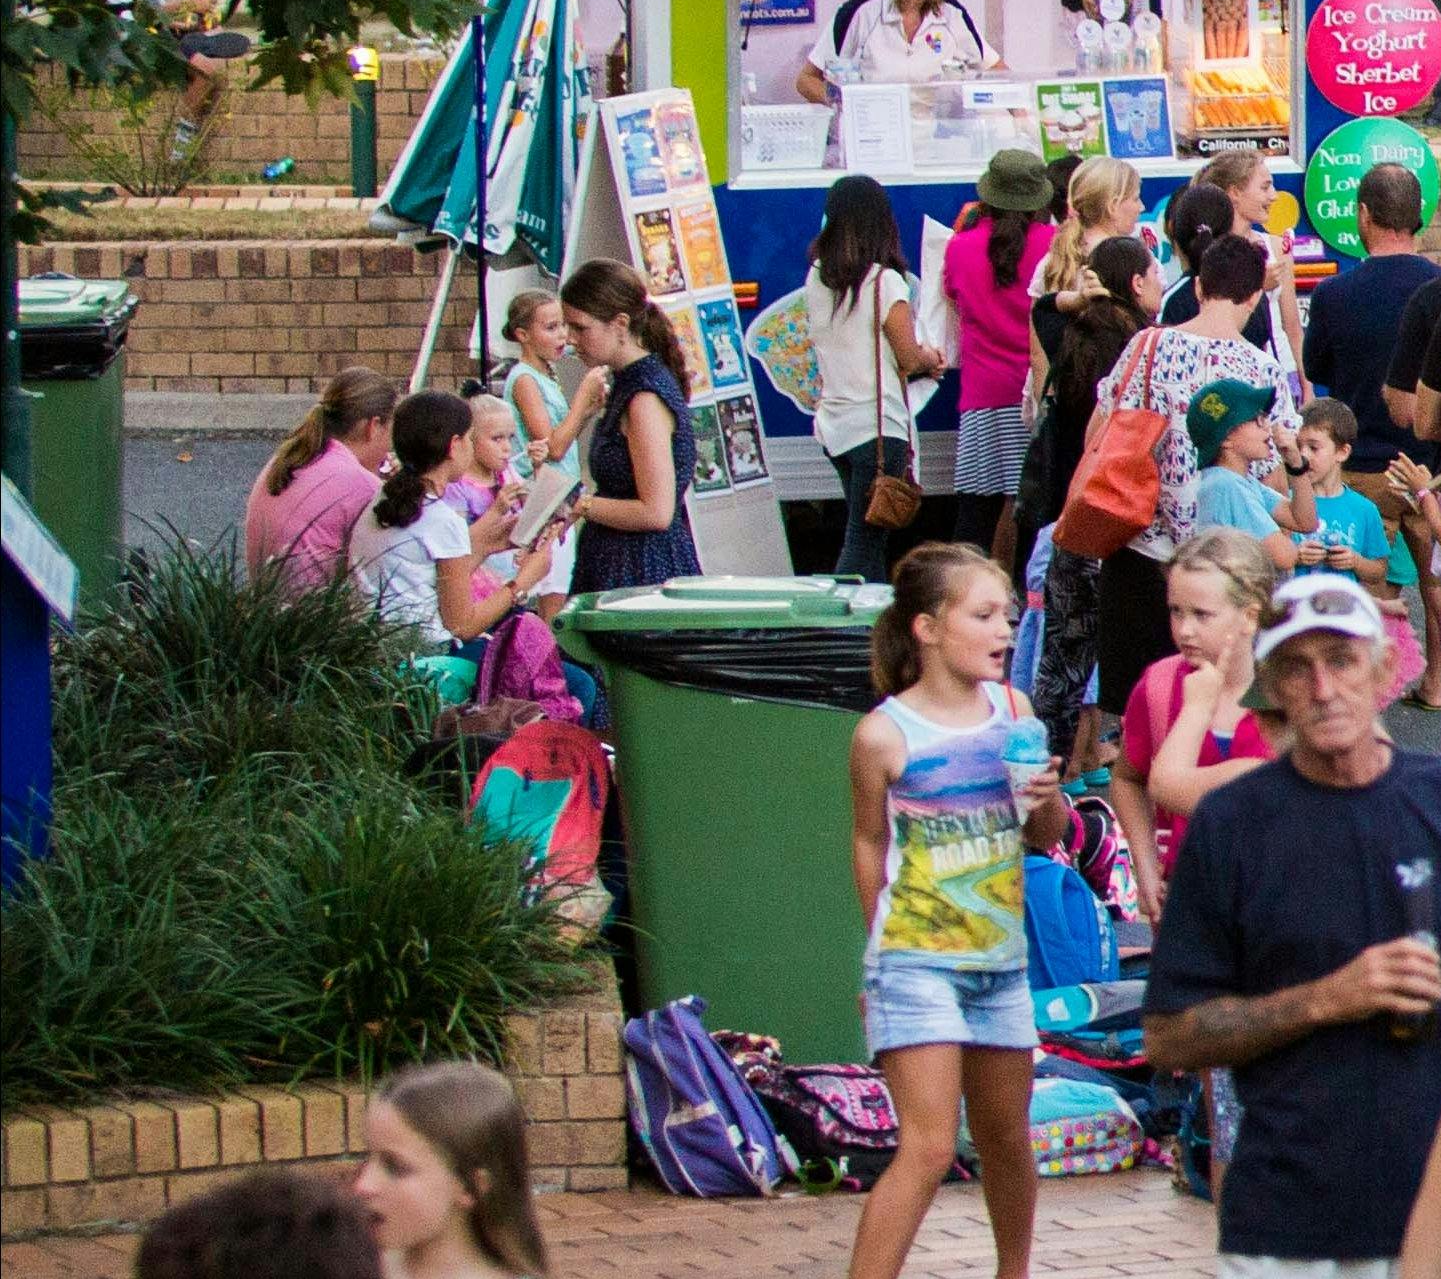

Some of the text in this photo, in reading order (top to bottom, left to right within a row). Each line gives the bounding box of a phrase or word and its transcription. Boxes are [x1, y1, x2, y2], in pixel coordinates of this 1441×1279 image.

[1323, 3, 1437, 27] Ice Cream
[1331, 30, 1428, 59] Yoghurt
[1336, 63, 1421, 85] Sherbet
[1364, 92, 1397, 113] Ice
[1199, 137, 1258, 151] California
[1319, 144, 1425, 168] Non Dairy
